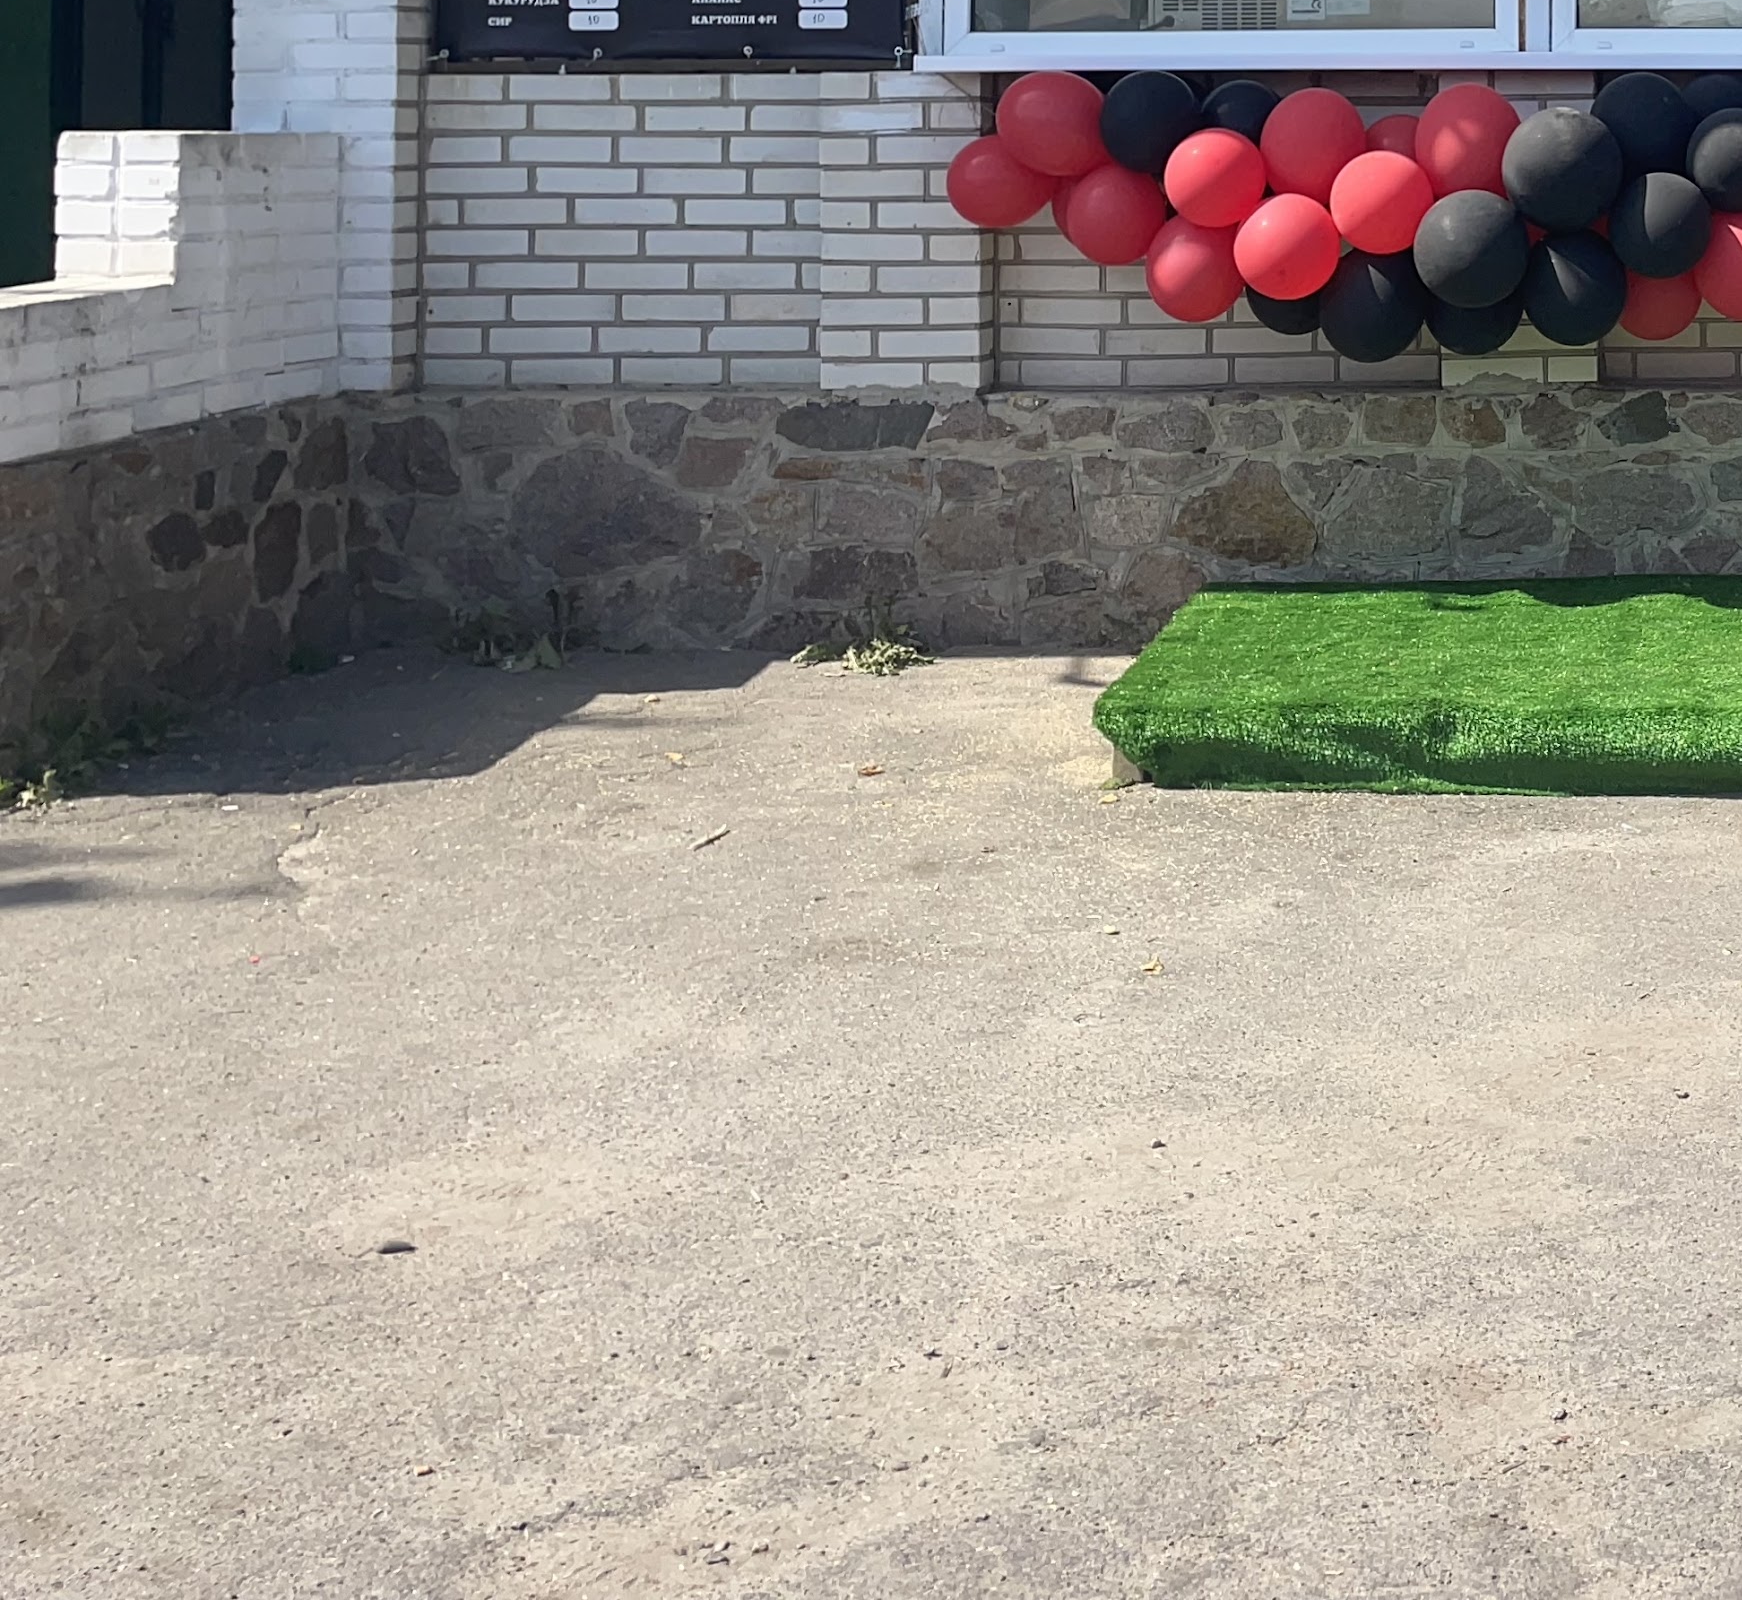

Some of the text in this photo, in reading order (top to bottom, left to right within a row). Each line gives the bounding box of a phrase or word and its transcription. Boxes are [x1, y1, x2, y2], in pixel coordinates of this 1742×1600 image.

[487, 16, 512, 27] СИР
[588, 14, 600, 25] 10
[691, 14, 778, 25] КАРТОПЛЯ ФРІ
[812, 13, 825, 24] 10
